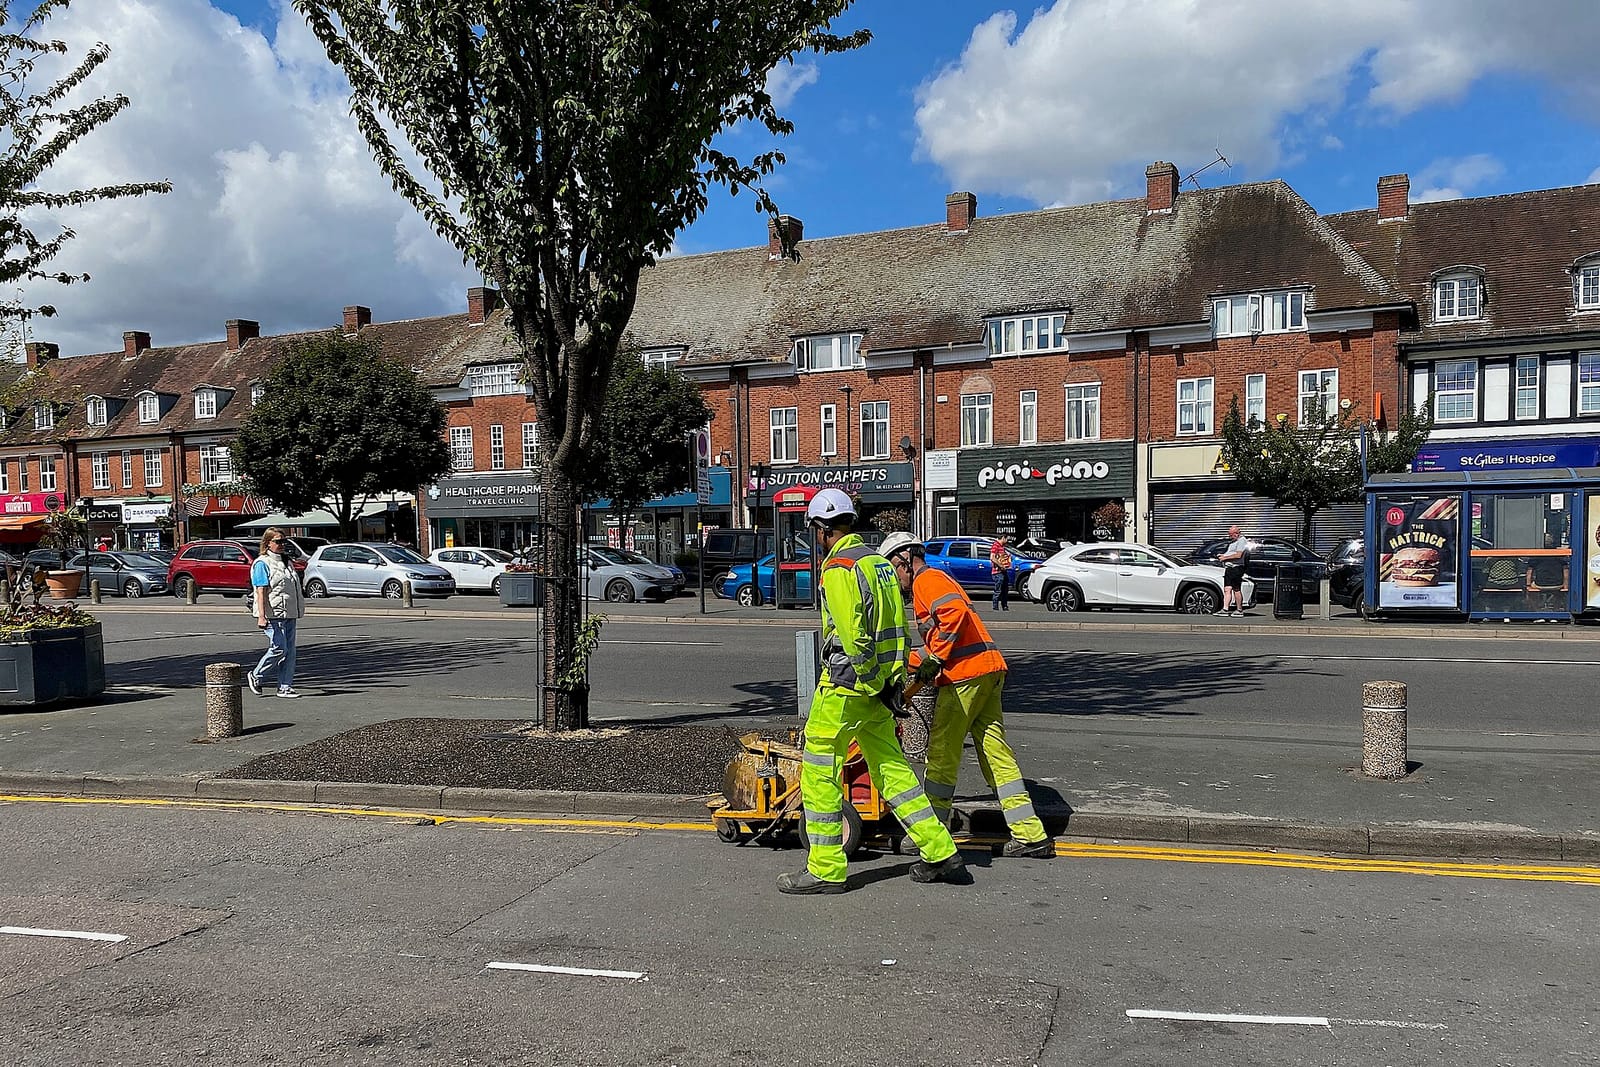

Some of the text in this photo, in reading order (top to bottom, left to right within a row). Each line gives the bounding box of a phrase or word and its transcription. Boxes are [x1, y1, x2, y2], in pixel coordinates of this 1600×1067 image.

[1509, 453, 1556, 466] Hospice
[768, 468, 888, 485] SUTTON CARPETS
[978, 460, 1030, 488] piri
[445, 486, 505, 497] HEALTHCARE
[1389, 532, 1446, 549] HAT TRICK
